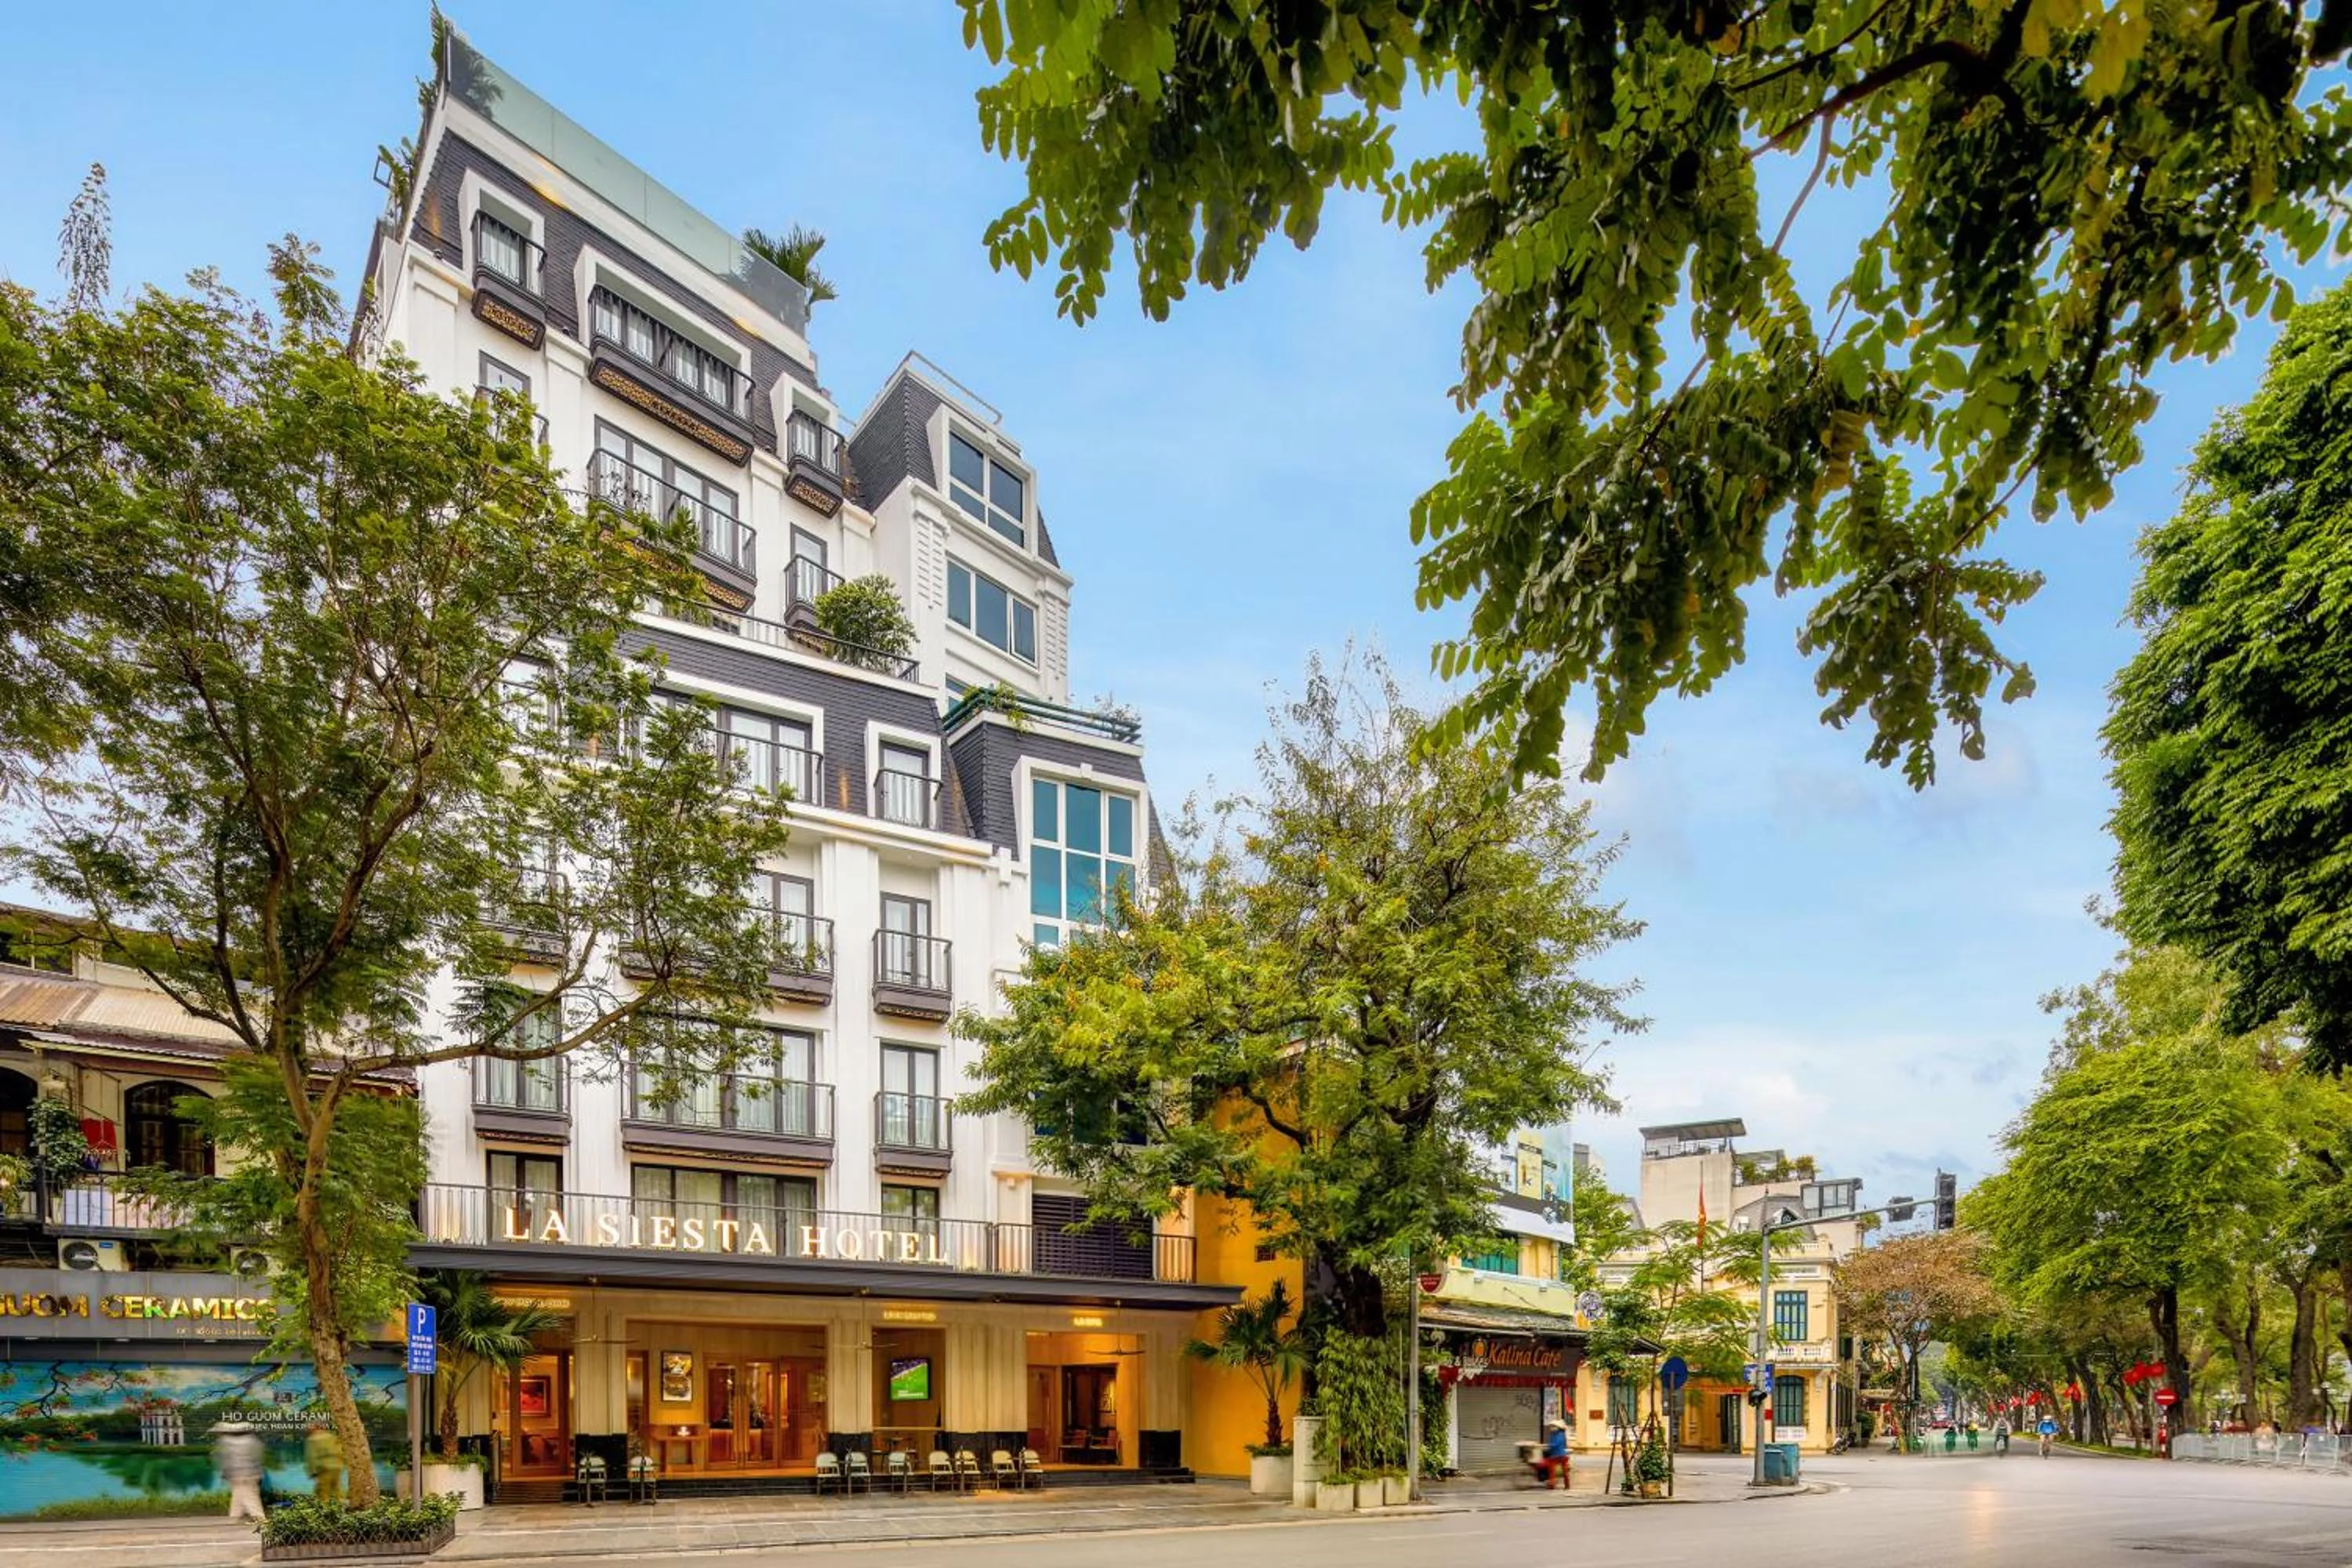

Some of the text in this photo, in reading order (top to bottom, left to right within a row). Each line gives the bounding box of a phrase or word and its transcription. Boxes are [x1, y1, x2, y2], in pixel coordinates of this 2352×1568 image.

[503, 1205, 948, 1264] LA SIESTA HOTEL
[0, 1292, 89, 1318] UOM
[418, 1307, 426, 1334] P
[1489, 1341, 1532, 1367] Kalina
[285, 1412, 333, 1421] CERAMI
